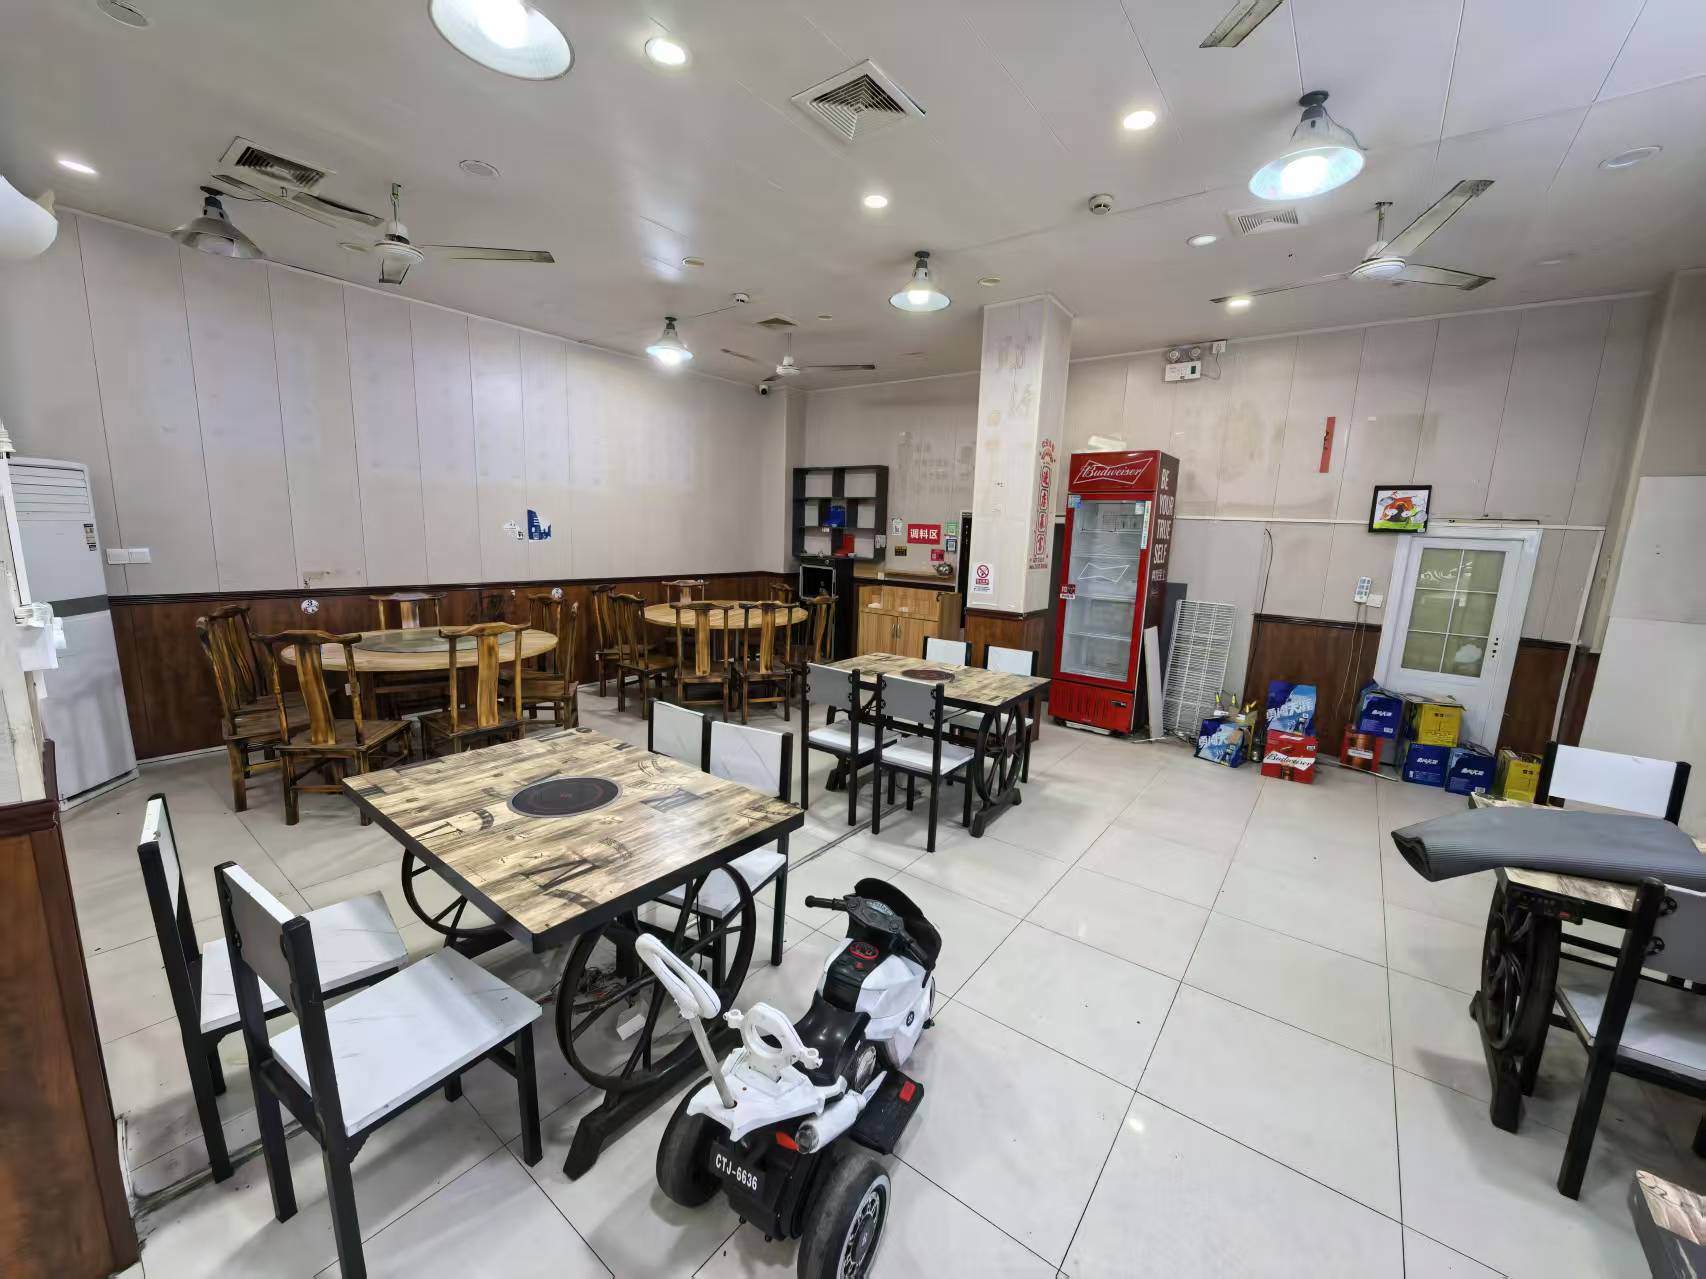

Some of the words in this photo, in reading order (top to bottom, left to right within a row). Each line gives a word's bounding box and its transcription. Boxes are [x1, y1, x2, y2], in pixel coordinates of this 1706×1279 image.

[1083, 465, 1143, 478] Budweiser
[1161, 469, 1170, 490] BE
[1159, 495, 1175, 516] YOUR
[910, 528, 938, 540] 调料区
[1157, 519, 1171, 539] TRUE
[1154, 544, 1167, 564] SELF
[1267, 753, 1311, 766] Budweiser
[715, 1154, 758, 1191] CTJ-6636
